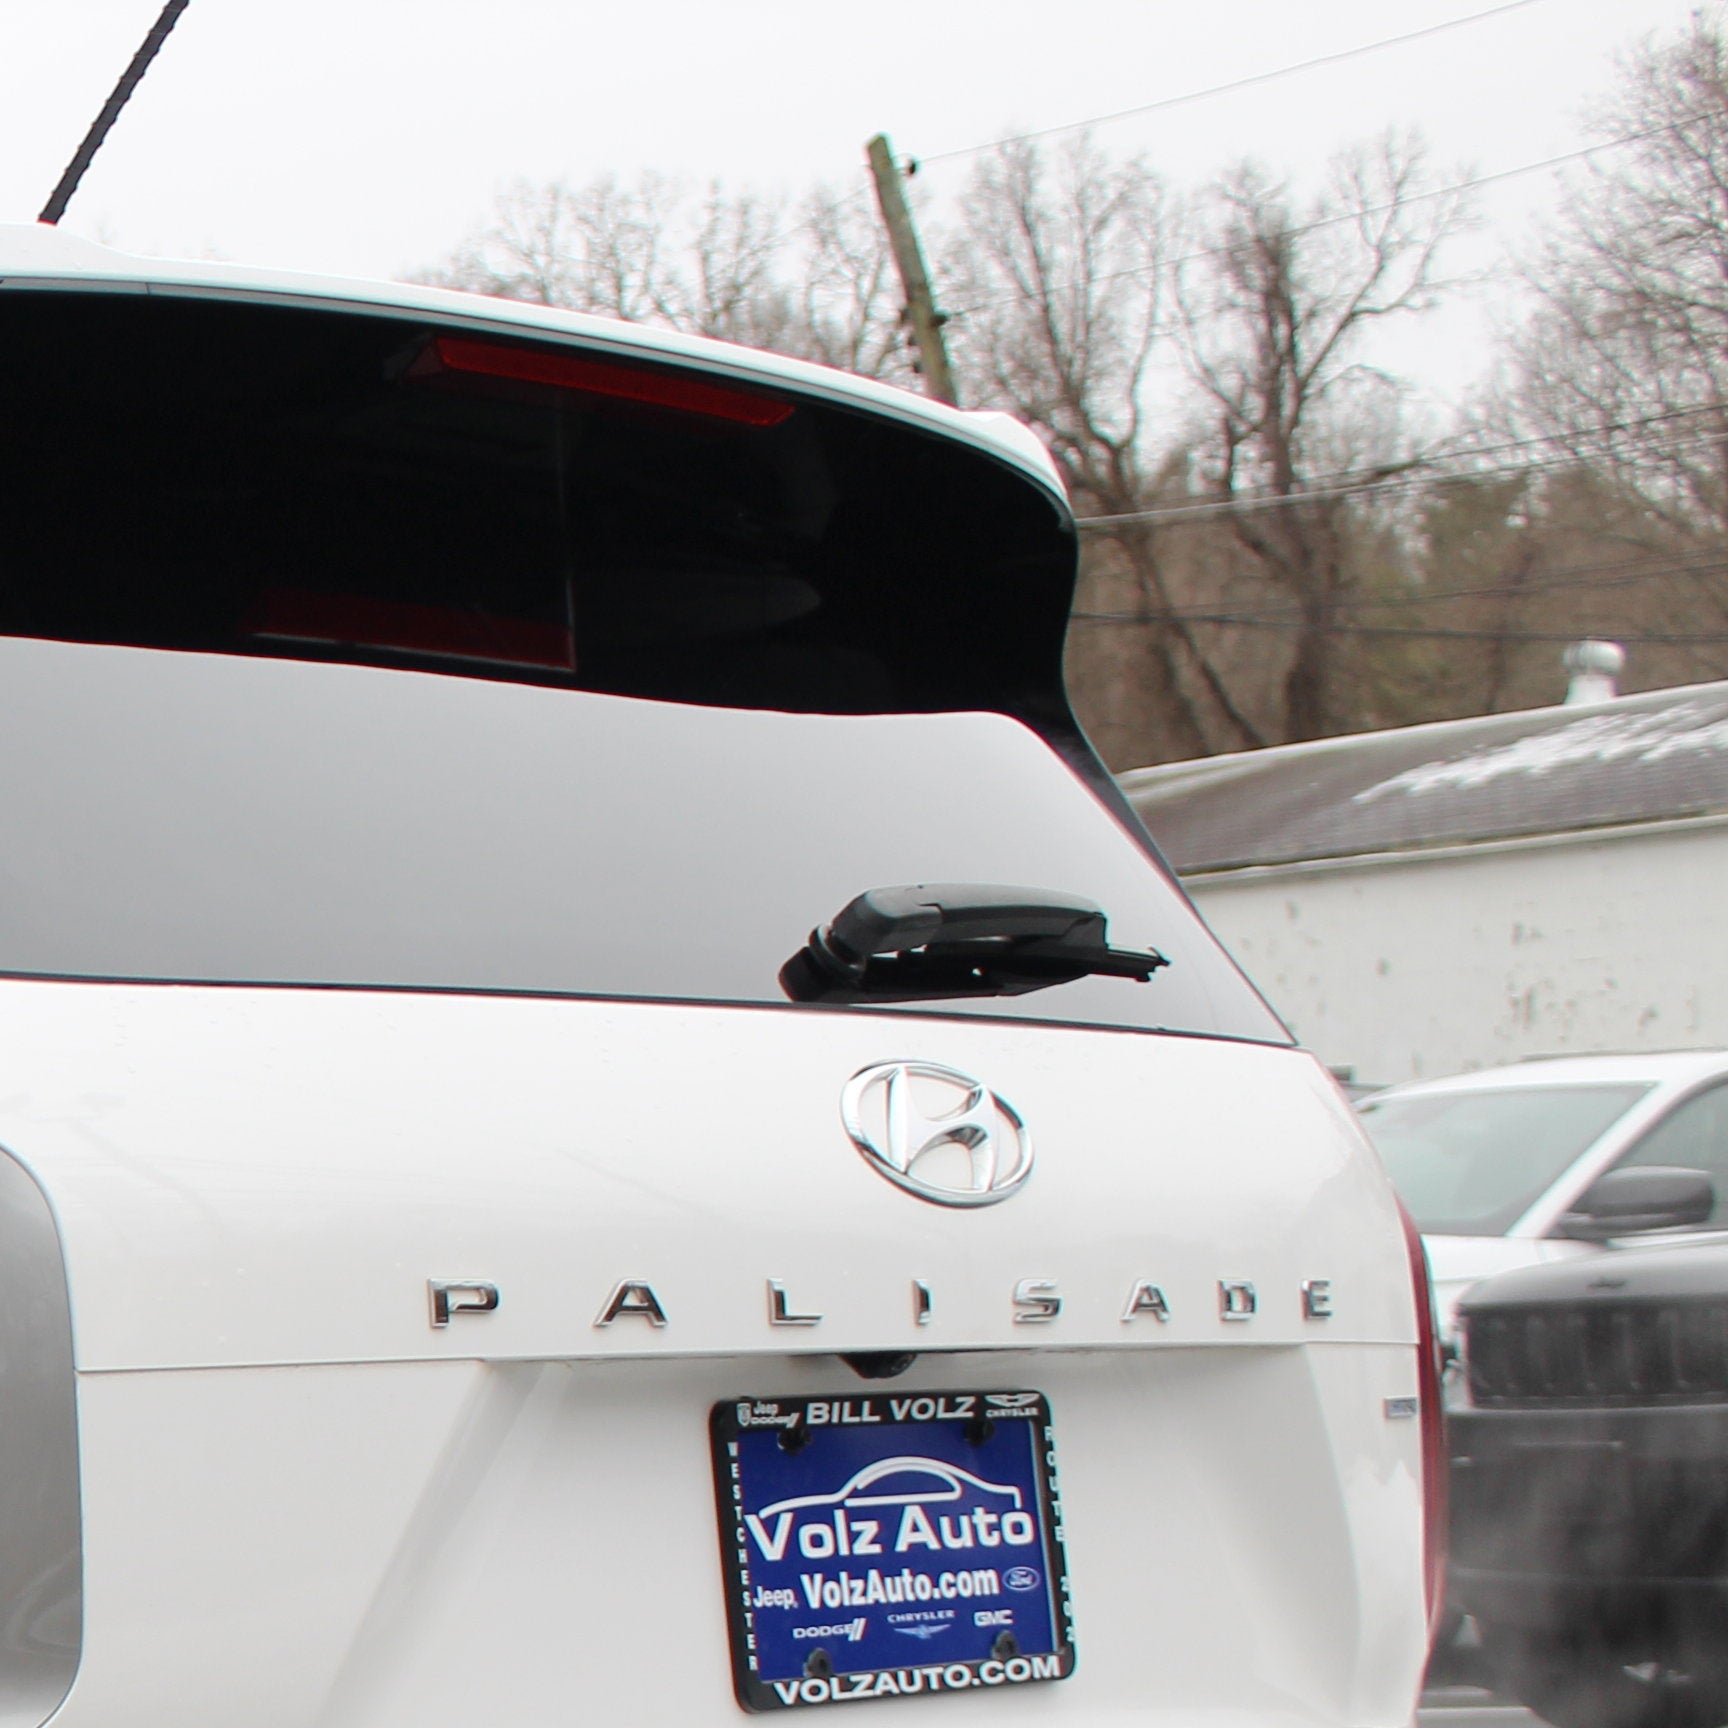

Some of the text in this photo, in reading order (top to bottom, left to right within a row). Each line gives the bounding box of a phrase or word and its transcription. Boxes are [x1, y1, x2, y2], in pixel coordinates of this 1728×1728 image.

[426, 1275, 1334, 1328] PALISADE
[806, 1396, 976, 1425] BILL VOLZ
[985, 1406, 1039, 1418] CHRYSLER
[745, 1504, 1034, 1562] Volz Auto
[727, 1441, 759, 1671] WESTCHESTER
[752, 1586, 796, 1610] Jeep
[800, 1567, 1000, 1609] VolzAuto.com
[793, 1621, 857, 1639] DODGE
[887, 1609, 955, 1623] CHRYSLER
[974, 1609, 1014, 1628] GMC
[773, 1655, 1061, 1706] VOLZAUTO.COM
